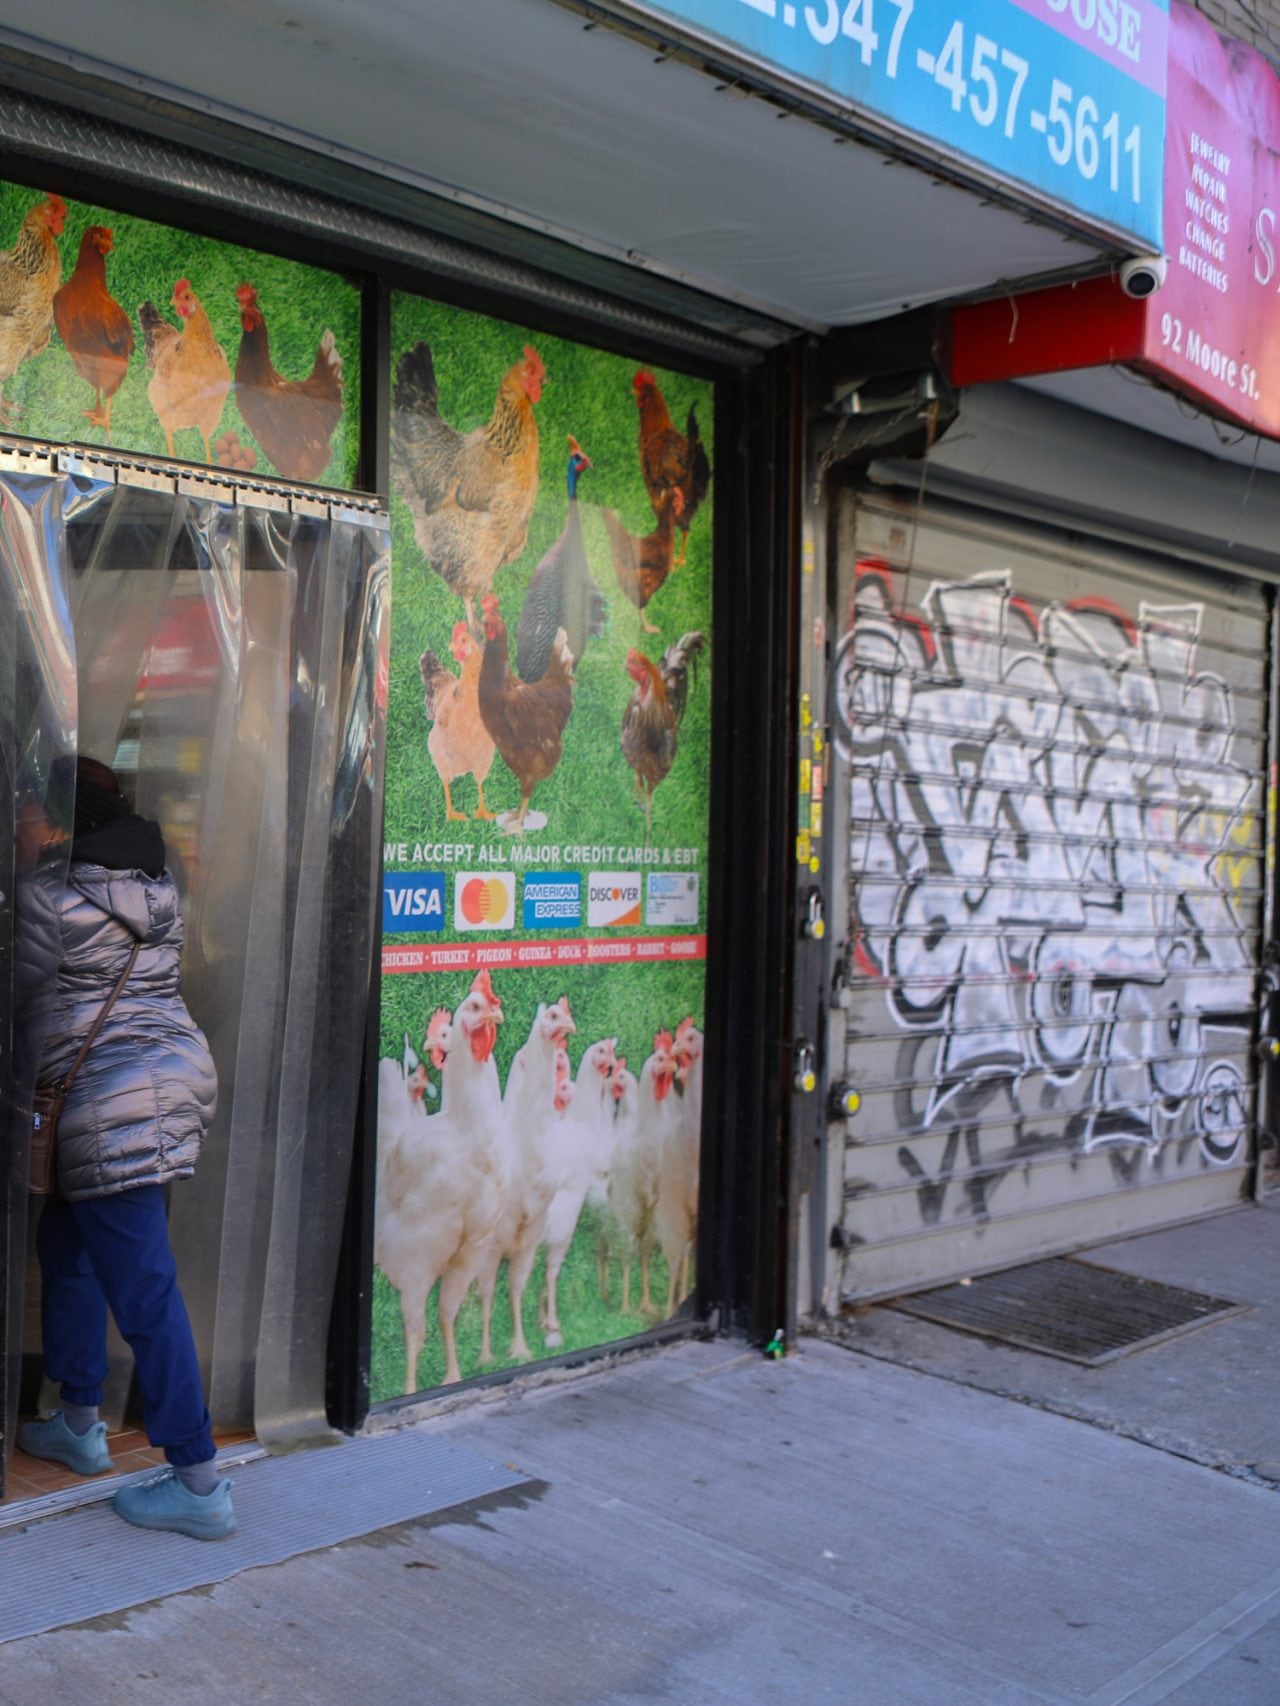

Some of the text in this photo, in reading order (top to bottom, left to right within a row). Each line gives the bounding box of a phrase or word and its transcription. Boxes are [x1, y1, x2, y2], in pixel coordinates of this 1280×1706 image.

[1046, 0, 1141, 63] OSE
[1192, 163, 1226, 203] REPAIR
[1185, 189, 1229, 235] WATCHES
[1185, 221, 1226, 262] CHANGE
[1179, 246, 1229, 292] BATTERIES
[1161, 312, 1260, 401] 92 Moore St.
[384, 843, 699, 864] WE ACCEPT ALL MAJOR CREDIT CARDS & EBT
[384, 888, 442, 916] VISA
[524, 885, 578, 898] AMERICAN
[590, 887, 639, 901] DISCOVER
[536, 903, 581, 917] EXPRESS
[382, 952, 423, 967] CHICKEN
[431, 950, 470, 965] TURKEY
[476, 949, 513, 963] PIGEON
[519, 946, 552, 961] GUINEA
[558, 945, 582, 959] DUCK
[587, 944, 631, 957] ROOSTERS
